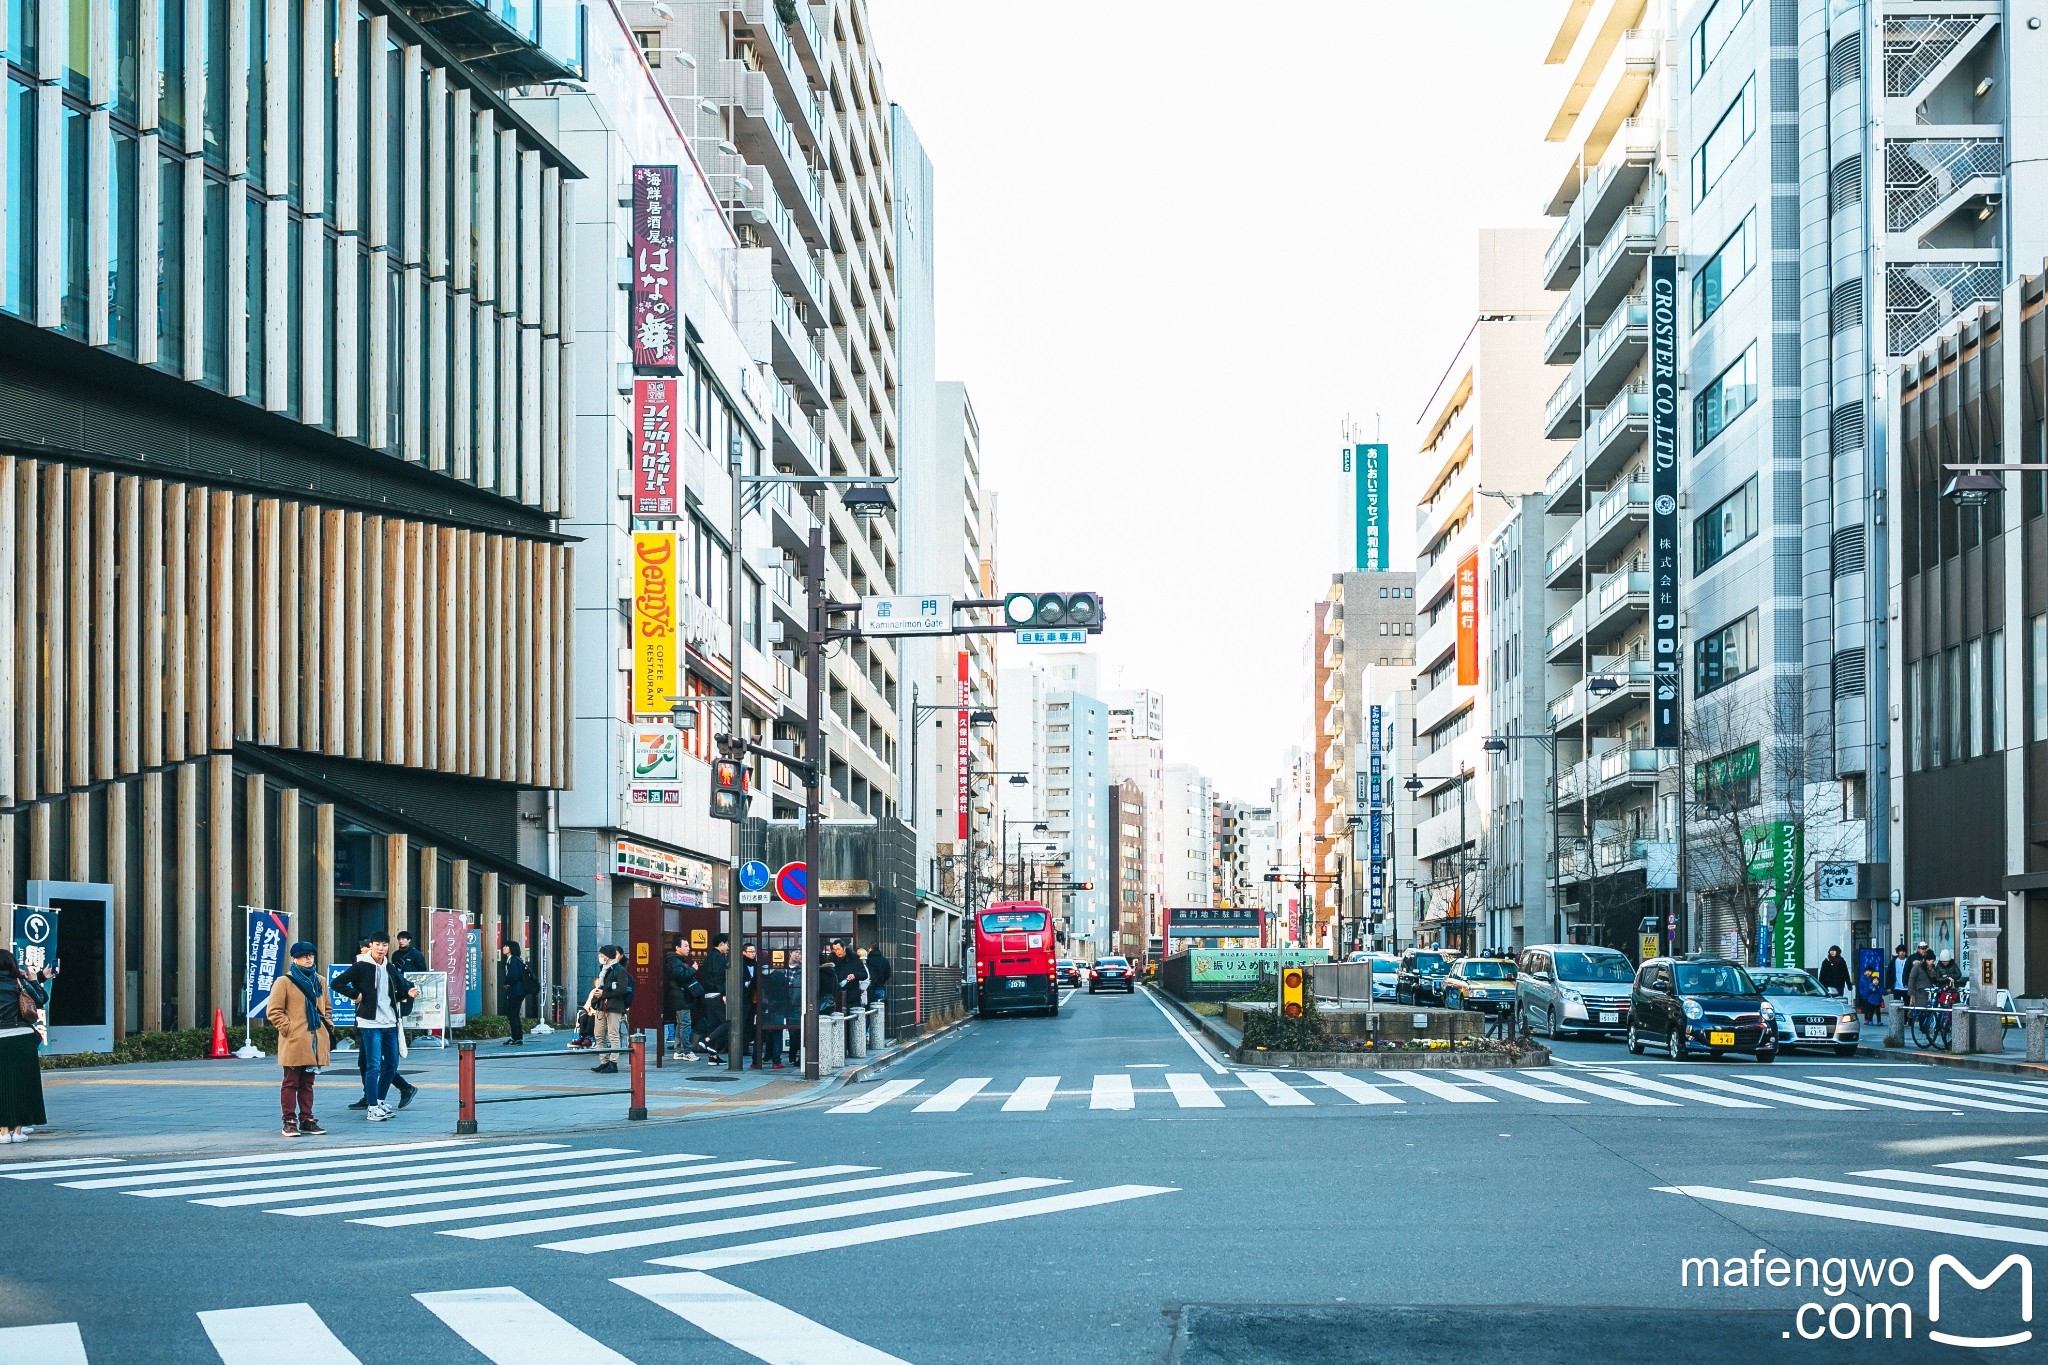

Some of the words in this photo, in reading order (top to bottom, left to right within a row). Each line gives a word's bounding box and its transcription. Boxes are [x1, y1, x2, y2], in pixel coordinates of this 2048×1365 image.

[646, 172, 662, 244] 海鮮居酒屋
[1655, 278, 1673, 378] CROSTER
[642, 405, 656, 491] コミックカフェ
[636, 539, 674, 638] Denny's
[1659, 538, 1672, 604] 株式会社
[877, 600, 937, 617] 雷門
[1460, 569, 1474, 629] 北陸銀行
[869, 619, 921, 629] Kaminarimon
[924, 618, 944, 629] Gate
[1022, 632, 1082, 642] 自転車専用
[633, 791, 647, 801] たばこ
[651, 791, 660, 802] 酒
[665, 791, 678, 802] ATM
[1372, 865, 1380, 908] 台東歯科
[1179, 910, 1252, 918] 雷門地下駐車場
[250, 921, 264, 961] Exchange
[257, 927, 280, 991] 外貨両替
[446, 918, 456, 983] ミハラシカフェ
